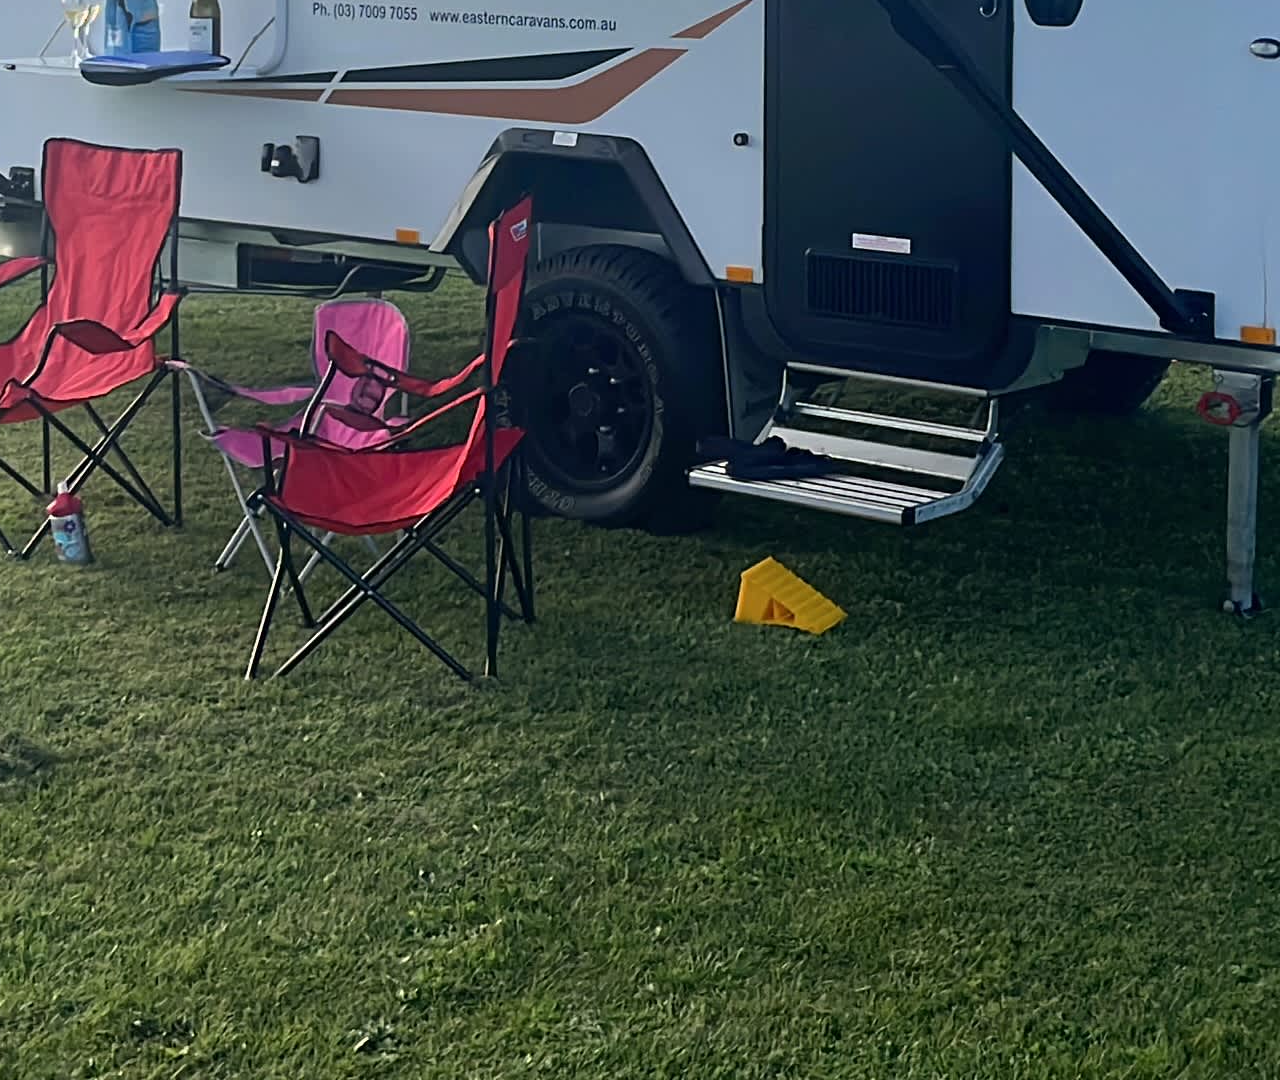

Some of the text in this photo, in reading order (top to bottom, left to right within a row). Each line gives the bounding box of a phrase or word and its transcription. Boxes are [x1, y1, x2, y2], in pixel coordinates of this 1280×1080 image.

[312, 2, 618, 32] Ph. (03) 7009 7055 www.easterncaravans.com.au
